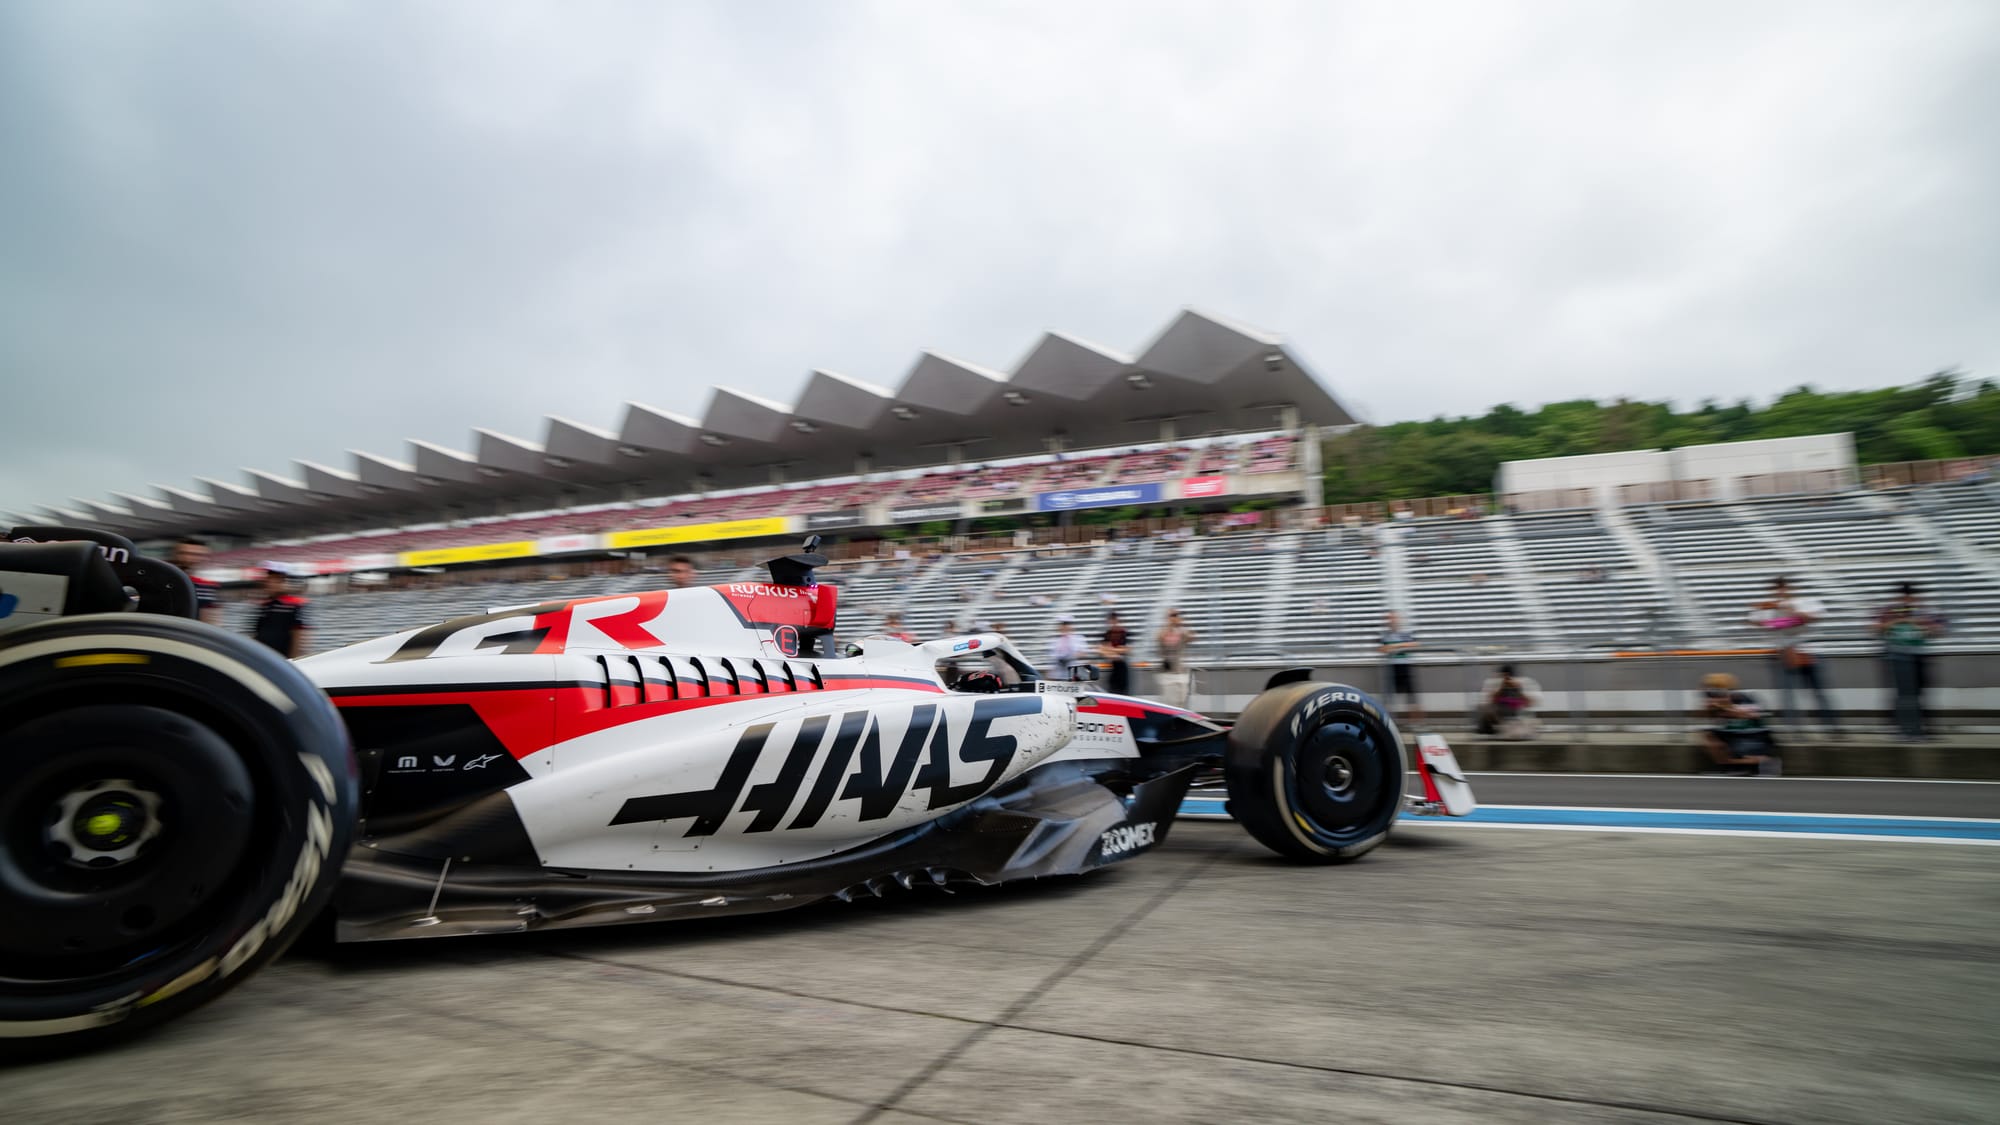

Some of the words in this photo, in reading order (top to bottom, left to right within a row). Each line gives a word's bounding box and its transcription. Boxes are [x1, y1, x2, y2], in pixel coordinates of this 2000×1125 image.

[729, 584, 798, 599] RUCKUS
[780, 628, 794, 653] E
[1047, 684, 1080, 693] emburse
[1303, 692, 1361, 720] ZERO
[608, 695, 1043, 838] HAAS
[1101, 821, 1158, 856] ZOOMEX
